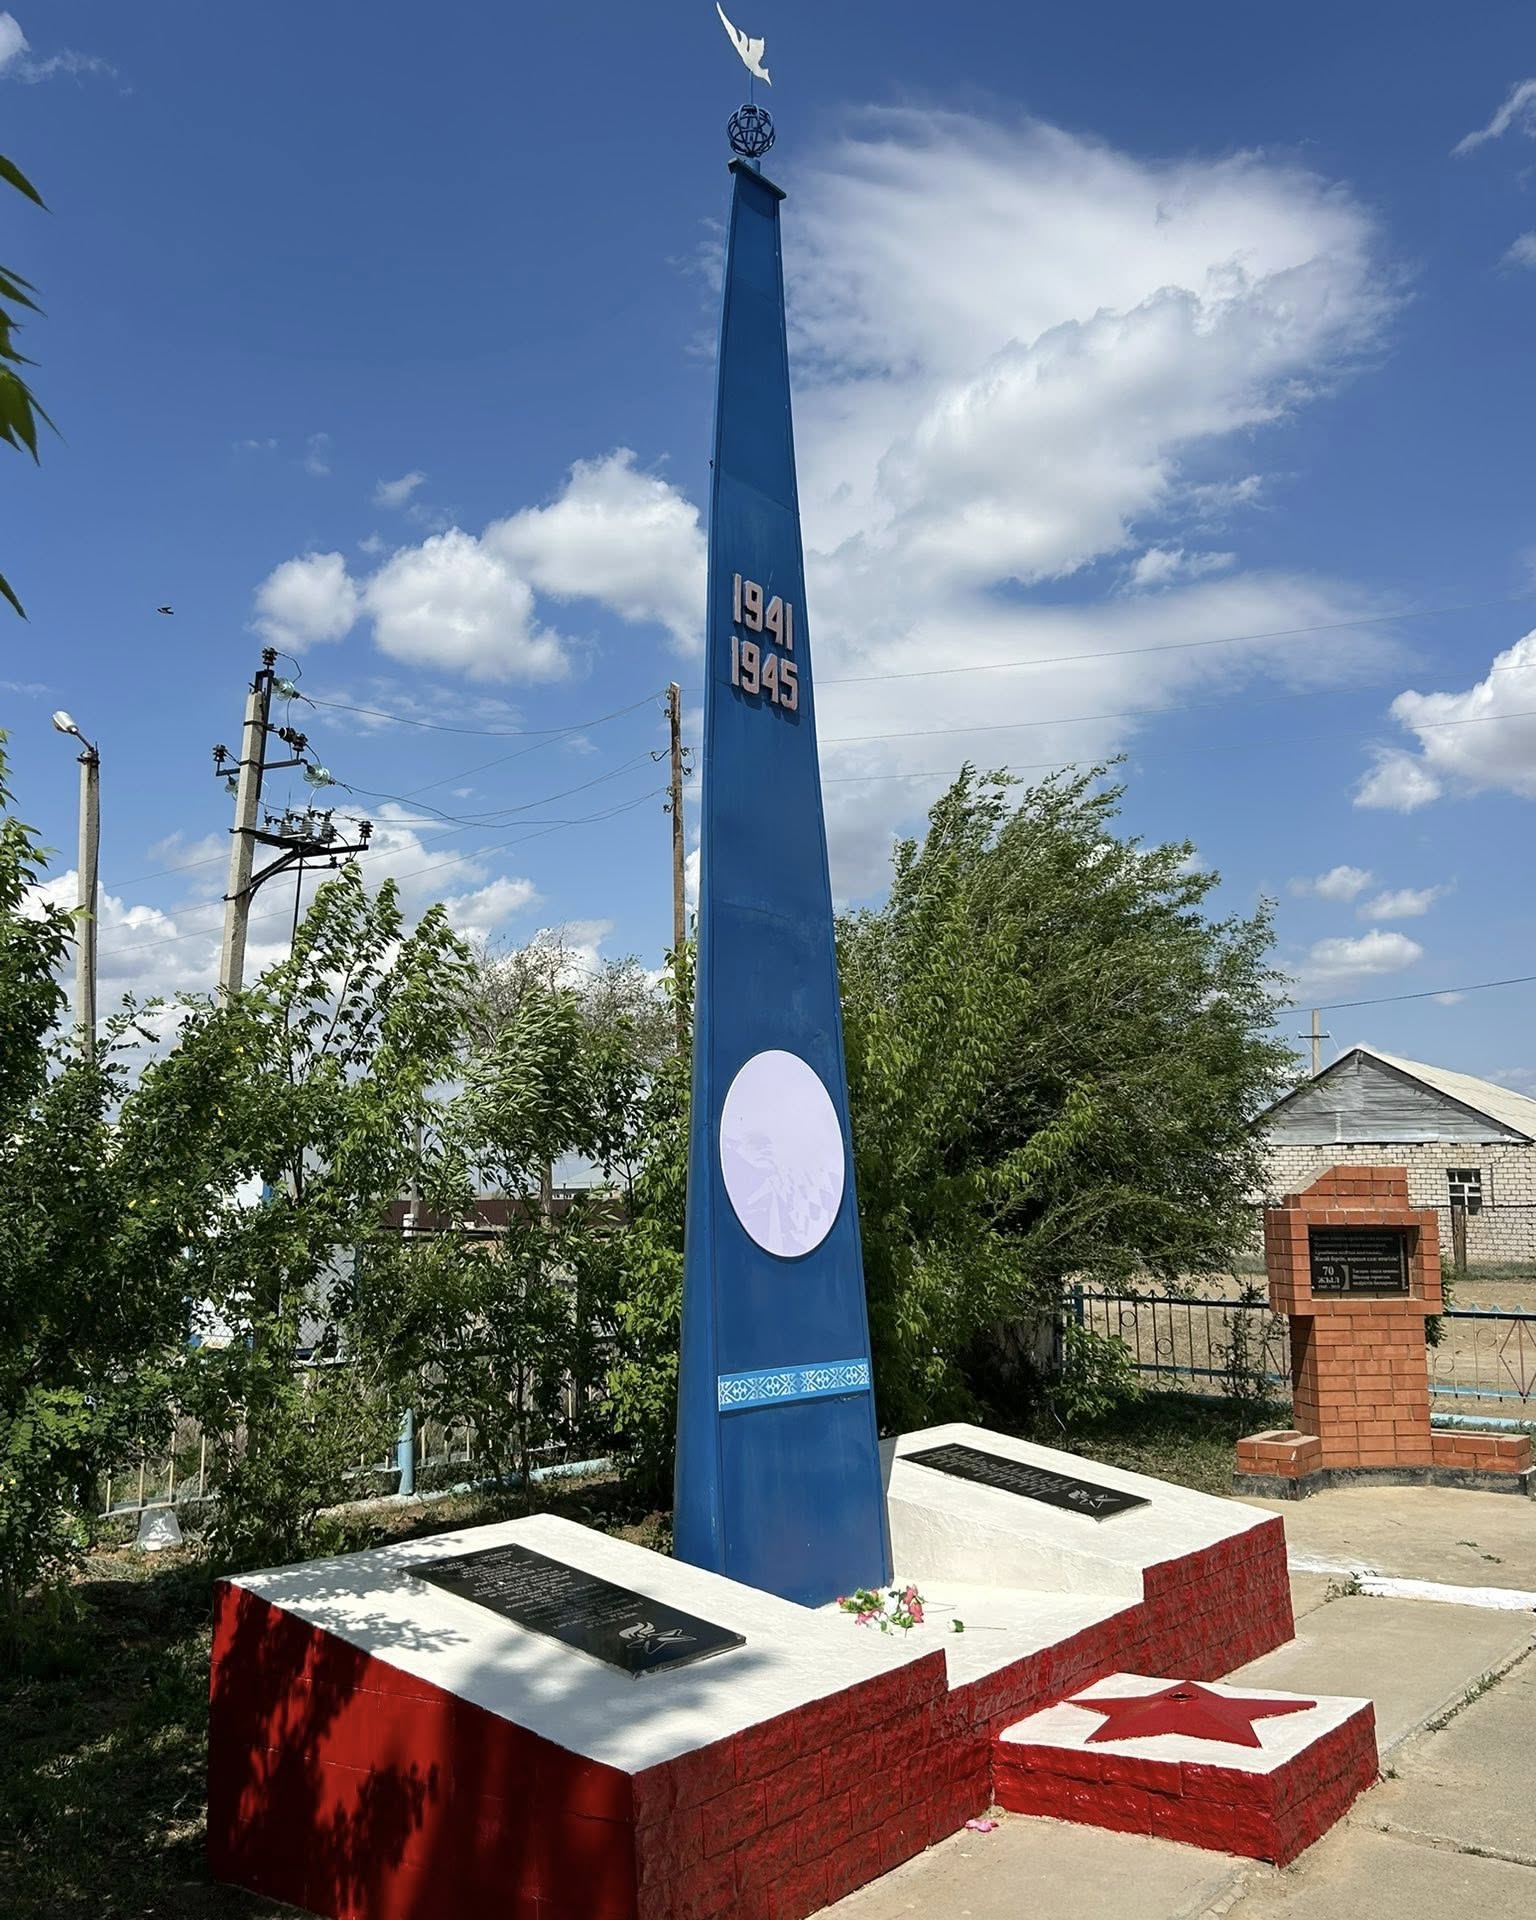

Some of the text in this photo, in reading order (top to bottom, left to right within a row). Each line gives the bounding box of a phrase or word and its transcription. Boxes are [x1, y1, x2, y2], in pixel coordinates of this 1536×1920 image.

[733, 573, 793, 650] 1941
[730, 636, 798, 710] 1945
[1322, 1266, 1334, 1276] 70
